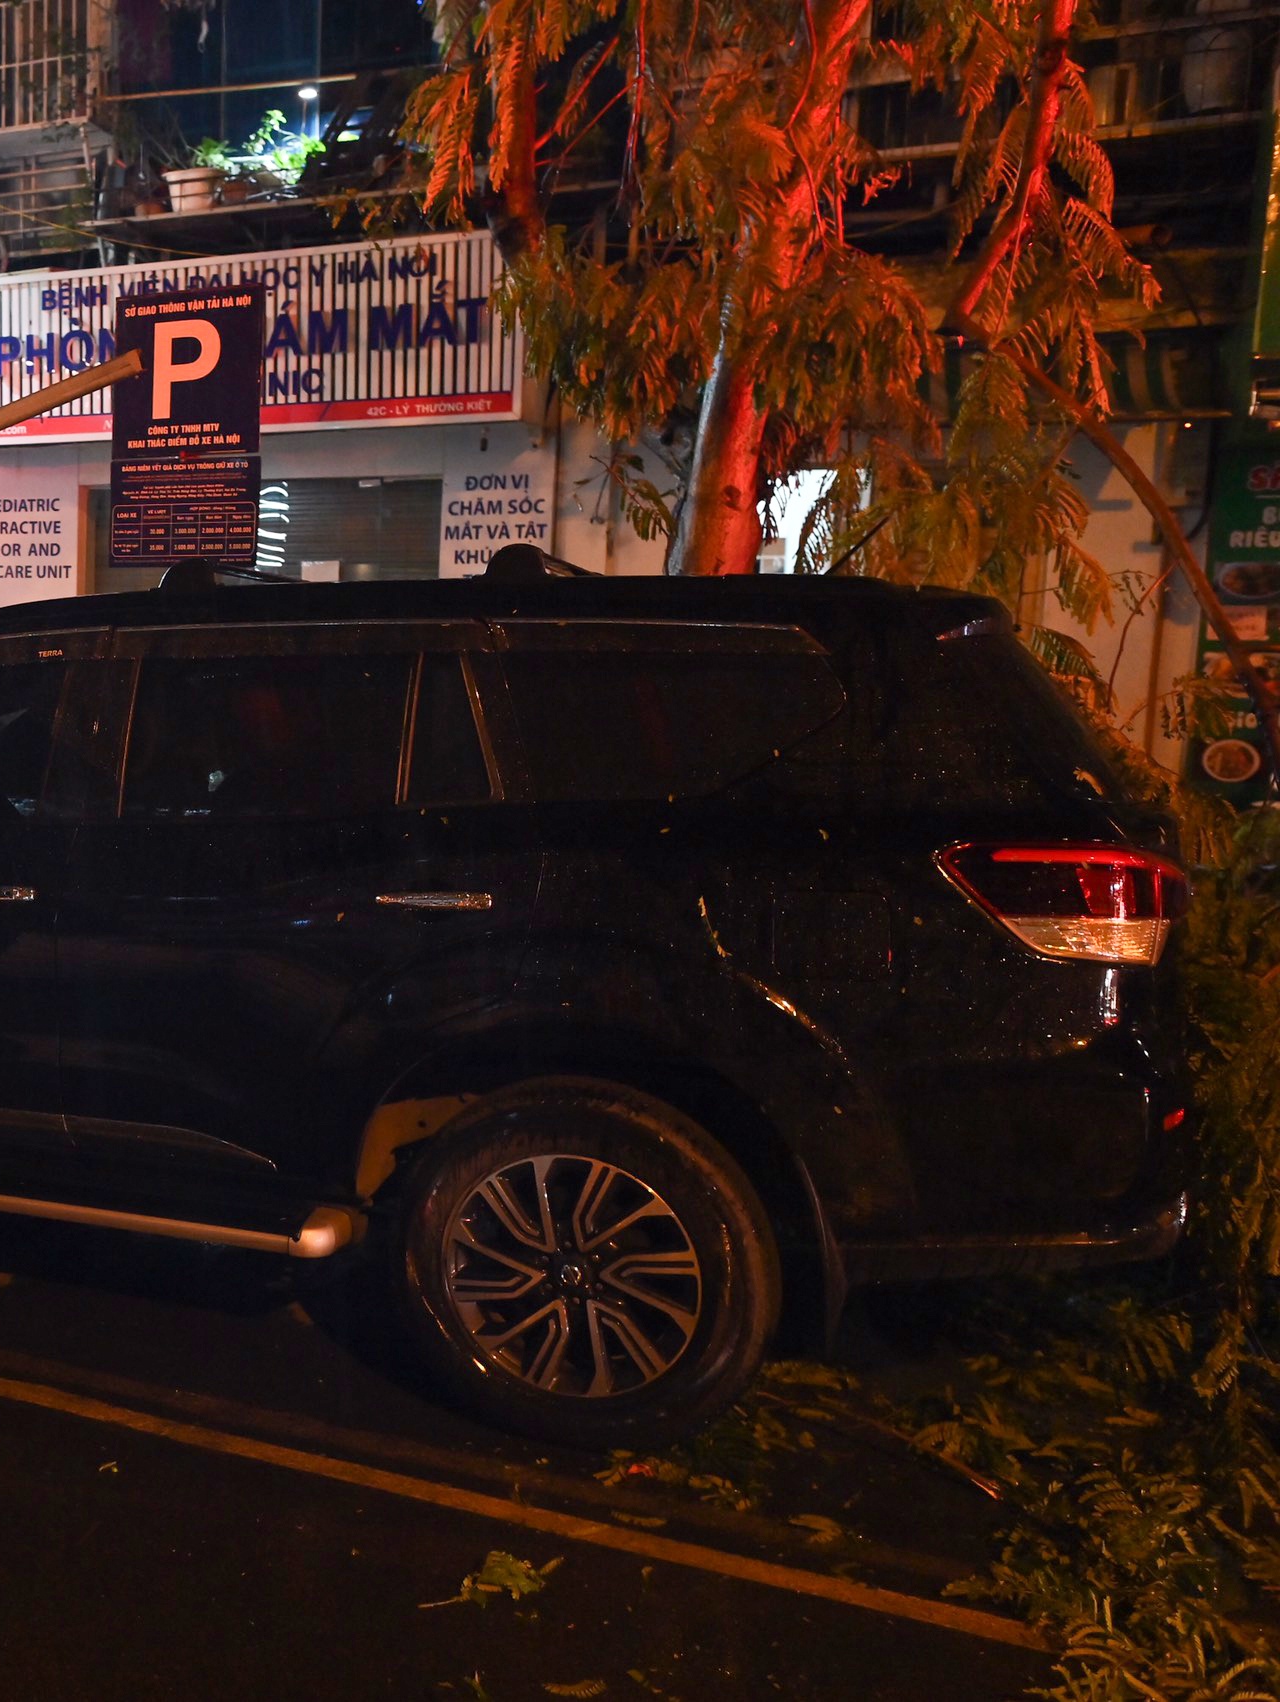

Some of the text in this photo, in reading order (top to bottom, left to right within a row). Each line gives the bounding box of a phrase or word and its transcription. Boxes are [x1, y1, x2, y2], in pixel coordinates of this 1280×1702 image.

[42, 281, 107, 315] BỆNH
[309, 263, 327, 287] Y
[337, 252, 380, 285] HÀ
[125, 294, 252, 318] SỞ GIAO THÔNG VẬN TẢI HÀ NỘI
[264, 300, 349, 358] ÁM
[371, 279, 489, 351] MẮT
[152, 319, 221, 420] P
[268, 367, 326, 397] NIC
[367, 406, 387, 416] 42C
[395, 403, 411, 415] LÝ
[415, 401, 464, 414] THƯỜNG
[467, 400, 493, 413] KIỆT
[148, 423, 220, 436] CÔNG TY TNHH MTV
[128, 433, 241, 449] KHAI THÁC ĐIỂM ĐỖ XE HÀ NỘI
[465, 474, 529, 493] ĐƠN VỊ
[448, 496, 545, 516] CHĂM SÓC
[444, 521, 548, 543] MẮT VÀ TẬT
[28, 543, 61, 557] AND
[454, 546, 494, 565] KHÚ
[36, 565, 72, 578] UNIT
[38, 649, 63, 658] TERRA
